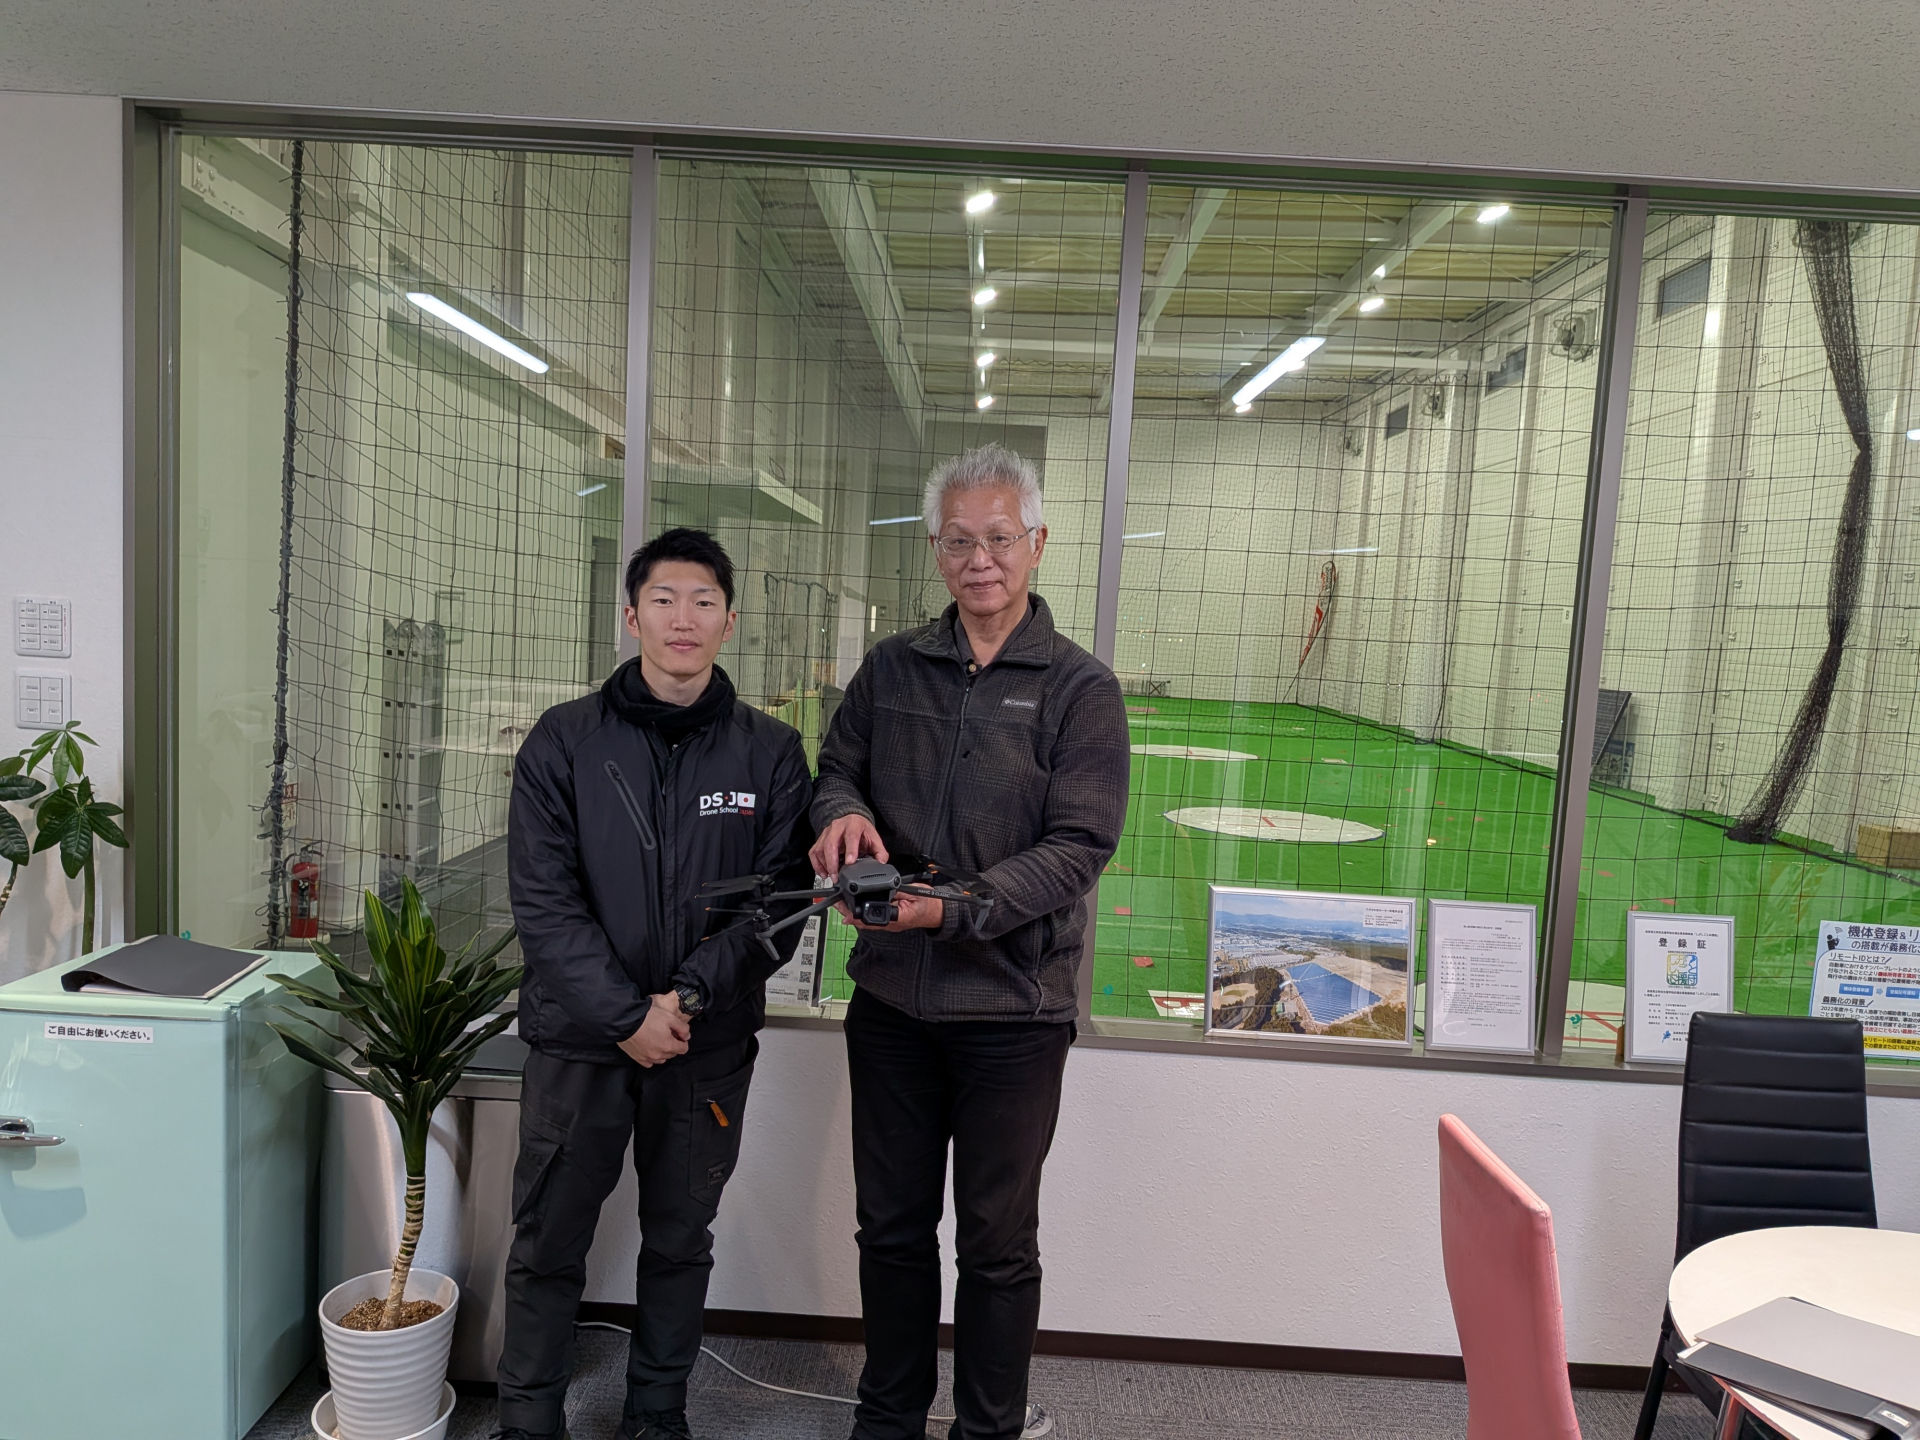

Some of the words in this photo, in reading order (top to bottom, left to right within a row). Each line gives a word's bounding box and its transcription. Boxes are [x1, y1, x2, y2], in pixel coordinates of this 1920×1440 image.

[1009, 699, 1035, 708] Columbia
[48, 1025, 151, 1041] ご自由にお使いください。
